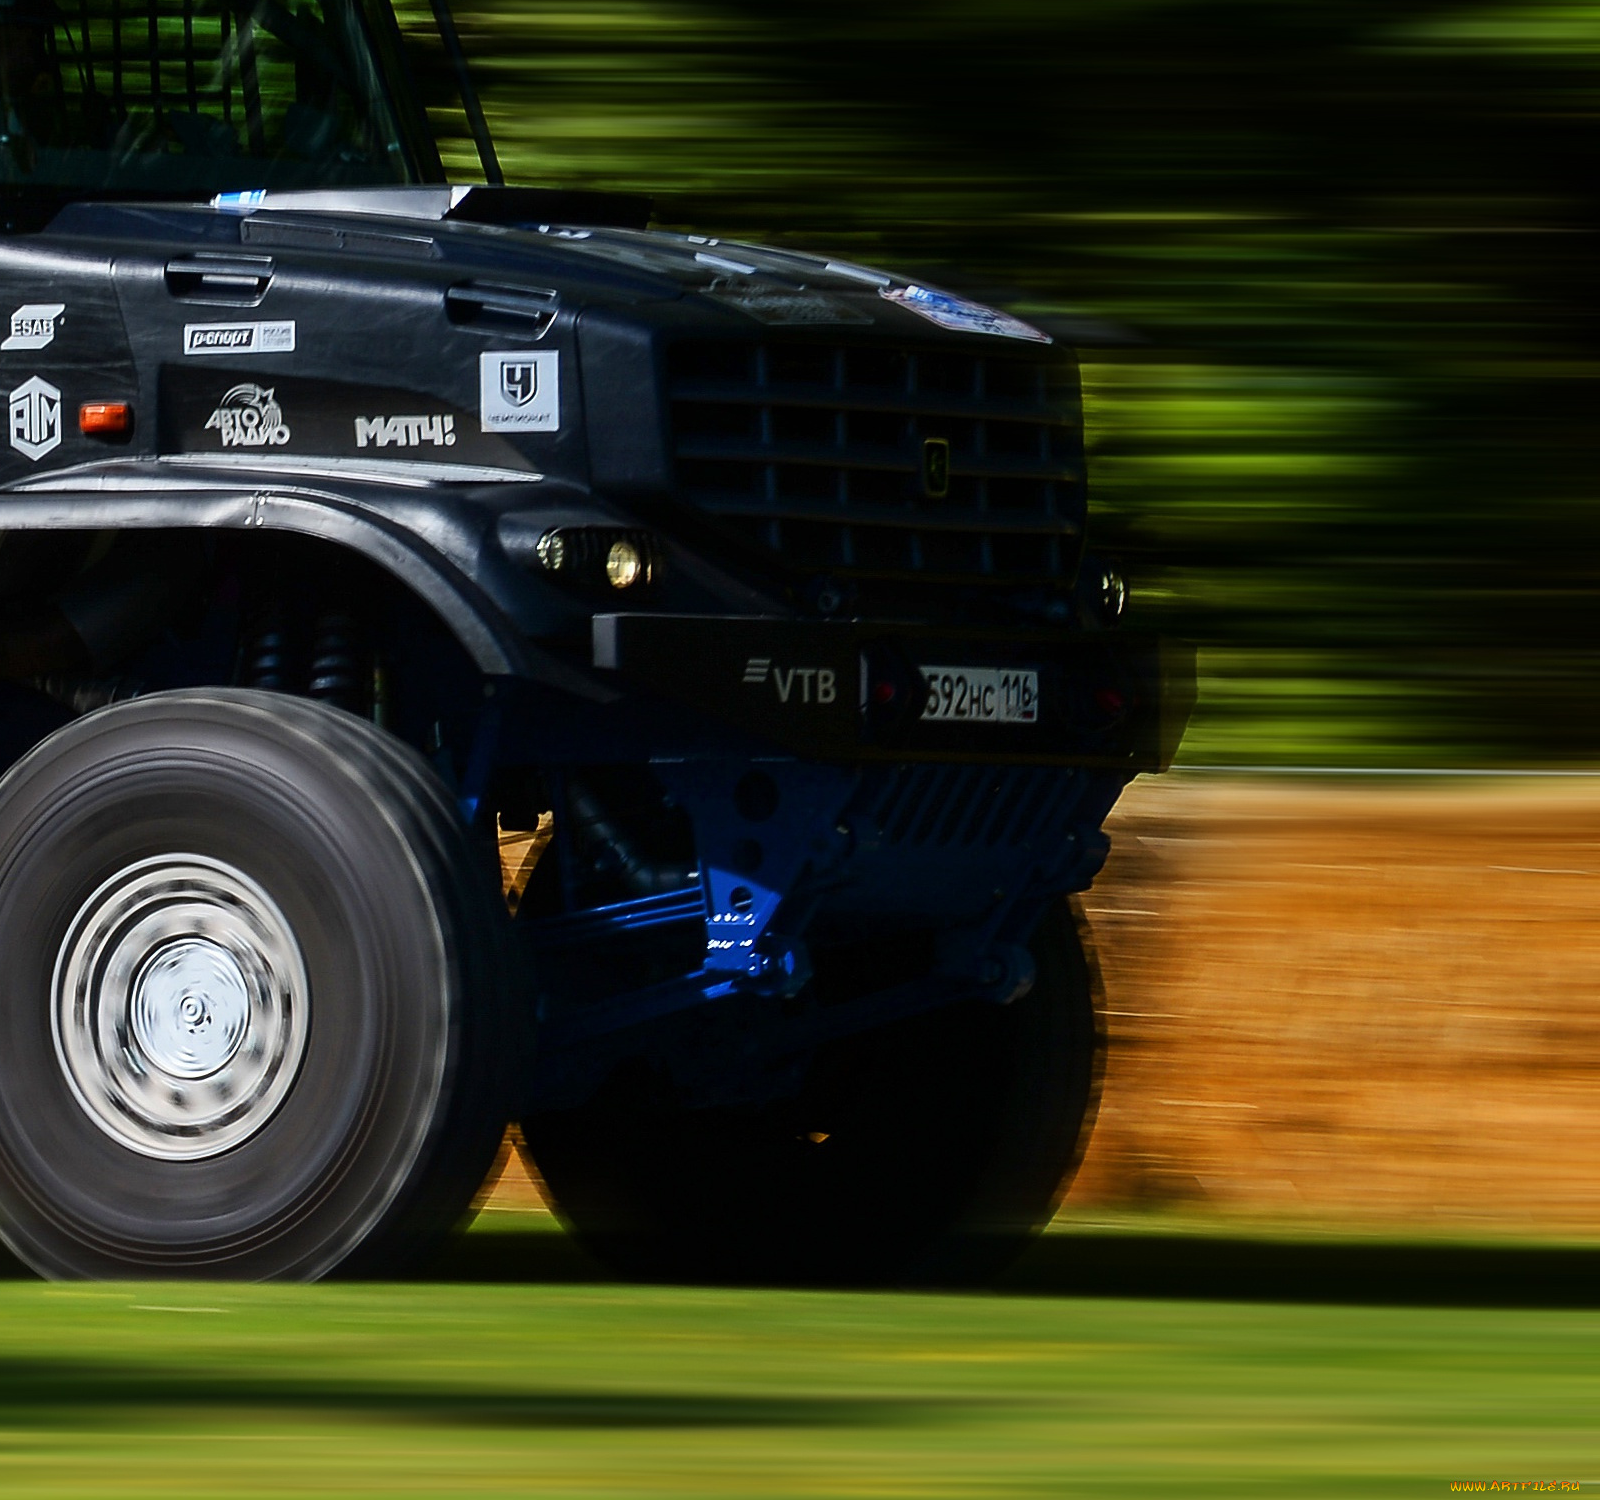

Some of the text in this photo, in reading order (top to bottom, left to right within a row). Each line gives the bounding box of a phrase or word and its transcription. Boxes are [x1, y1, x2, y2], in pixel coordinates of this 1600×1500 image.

[12, 319, 54, 336] ESAB
[204, 407, 258, 429] АВТО
[222, 423, 291, 446] РАДИО
[354, 414, 457, 447] МАТЧ!
[774, 668, 836, 703] VTB
